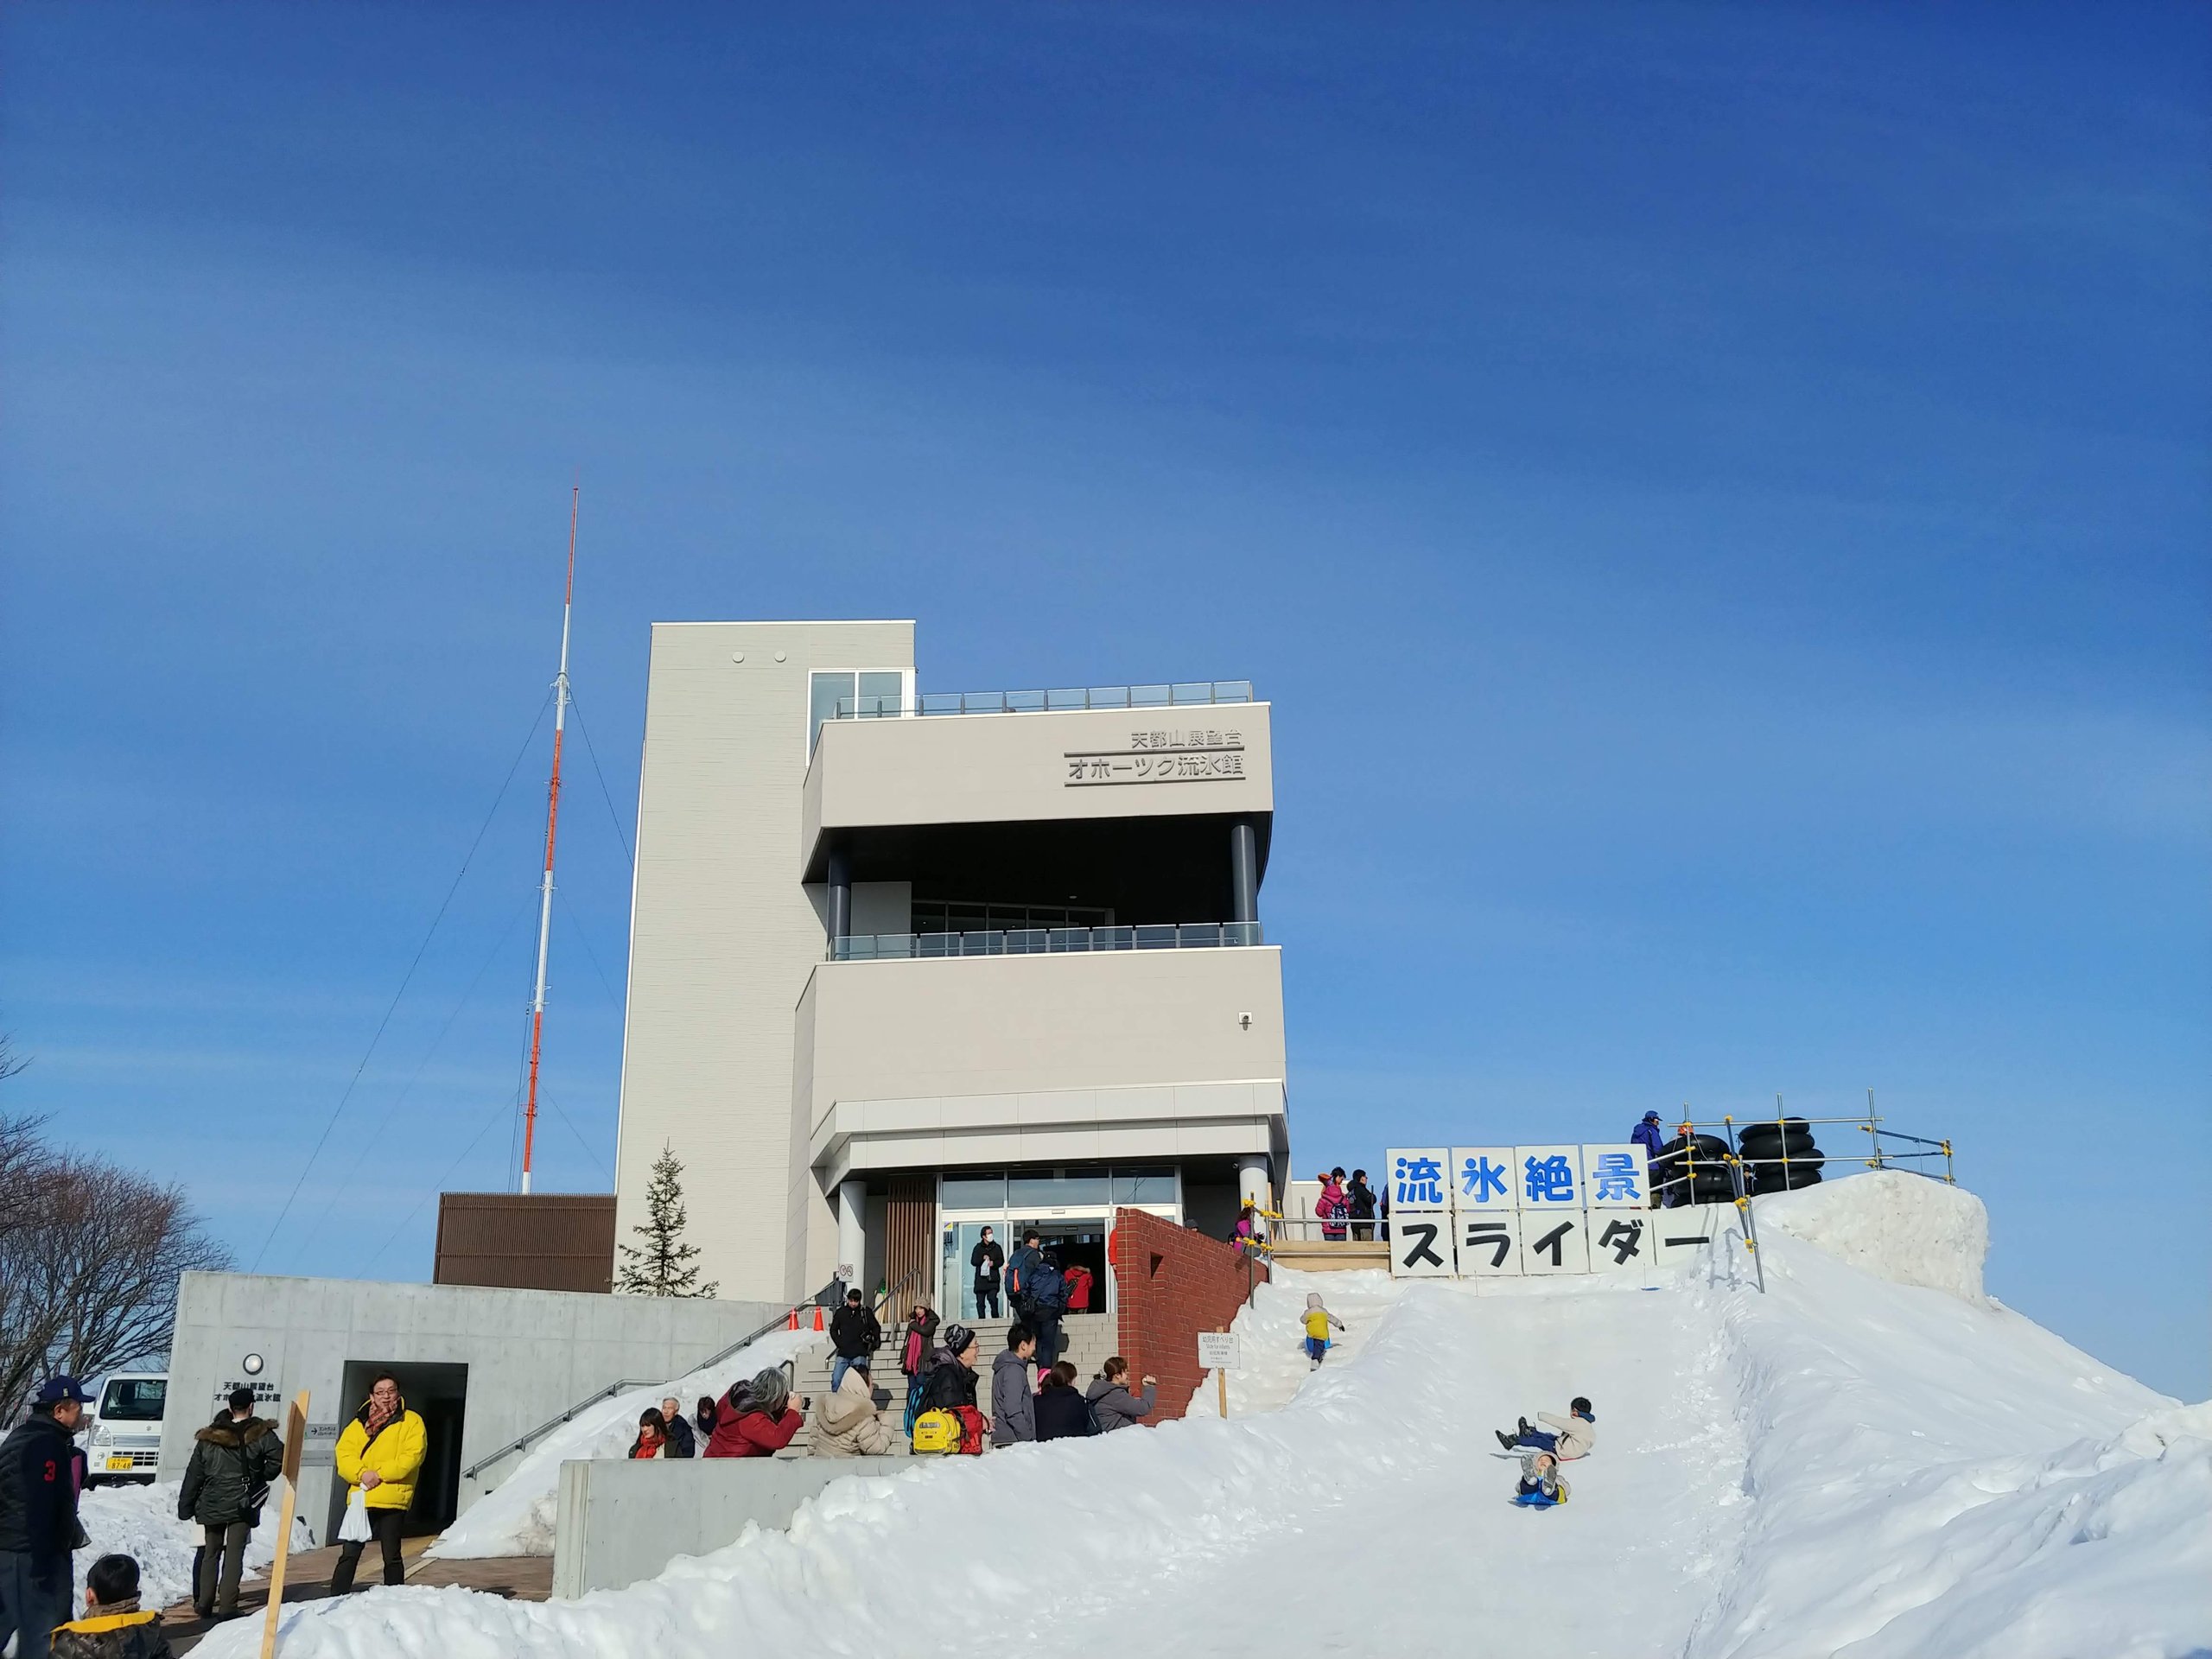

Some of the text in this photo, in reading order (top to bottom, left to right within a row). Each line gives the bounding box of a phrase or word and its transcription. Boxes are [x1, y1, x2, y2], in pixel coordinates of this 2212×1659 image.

[1130, 729, 1243, 748] 天都山展望台
[1069, 754, 1243, 779] オホーツク流氷館
[1395, 1153, 1641, 1204] 流氷絶景
[1402, 1217, 1710, 1268] スライダー
